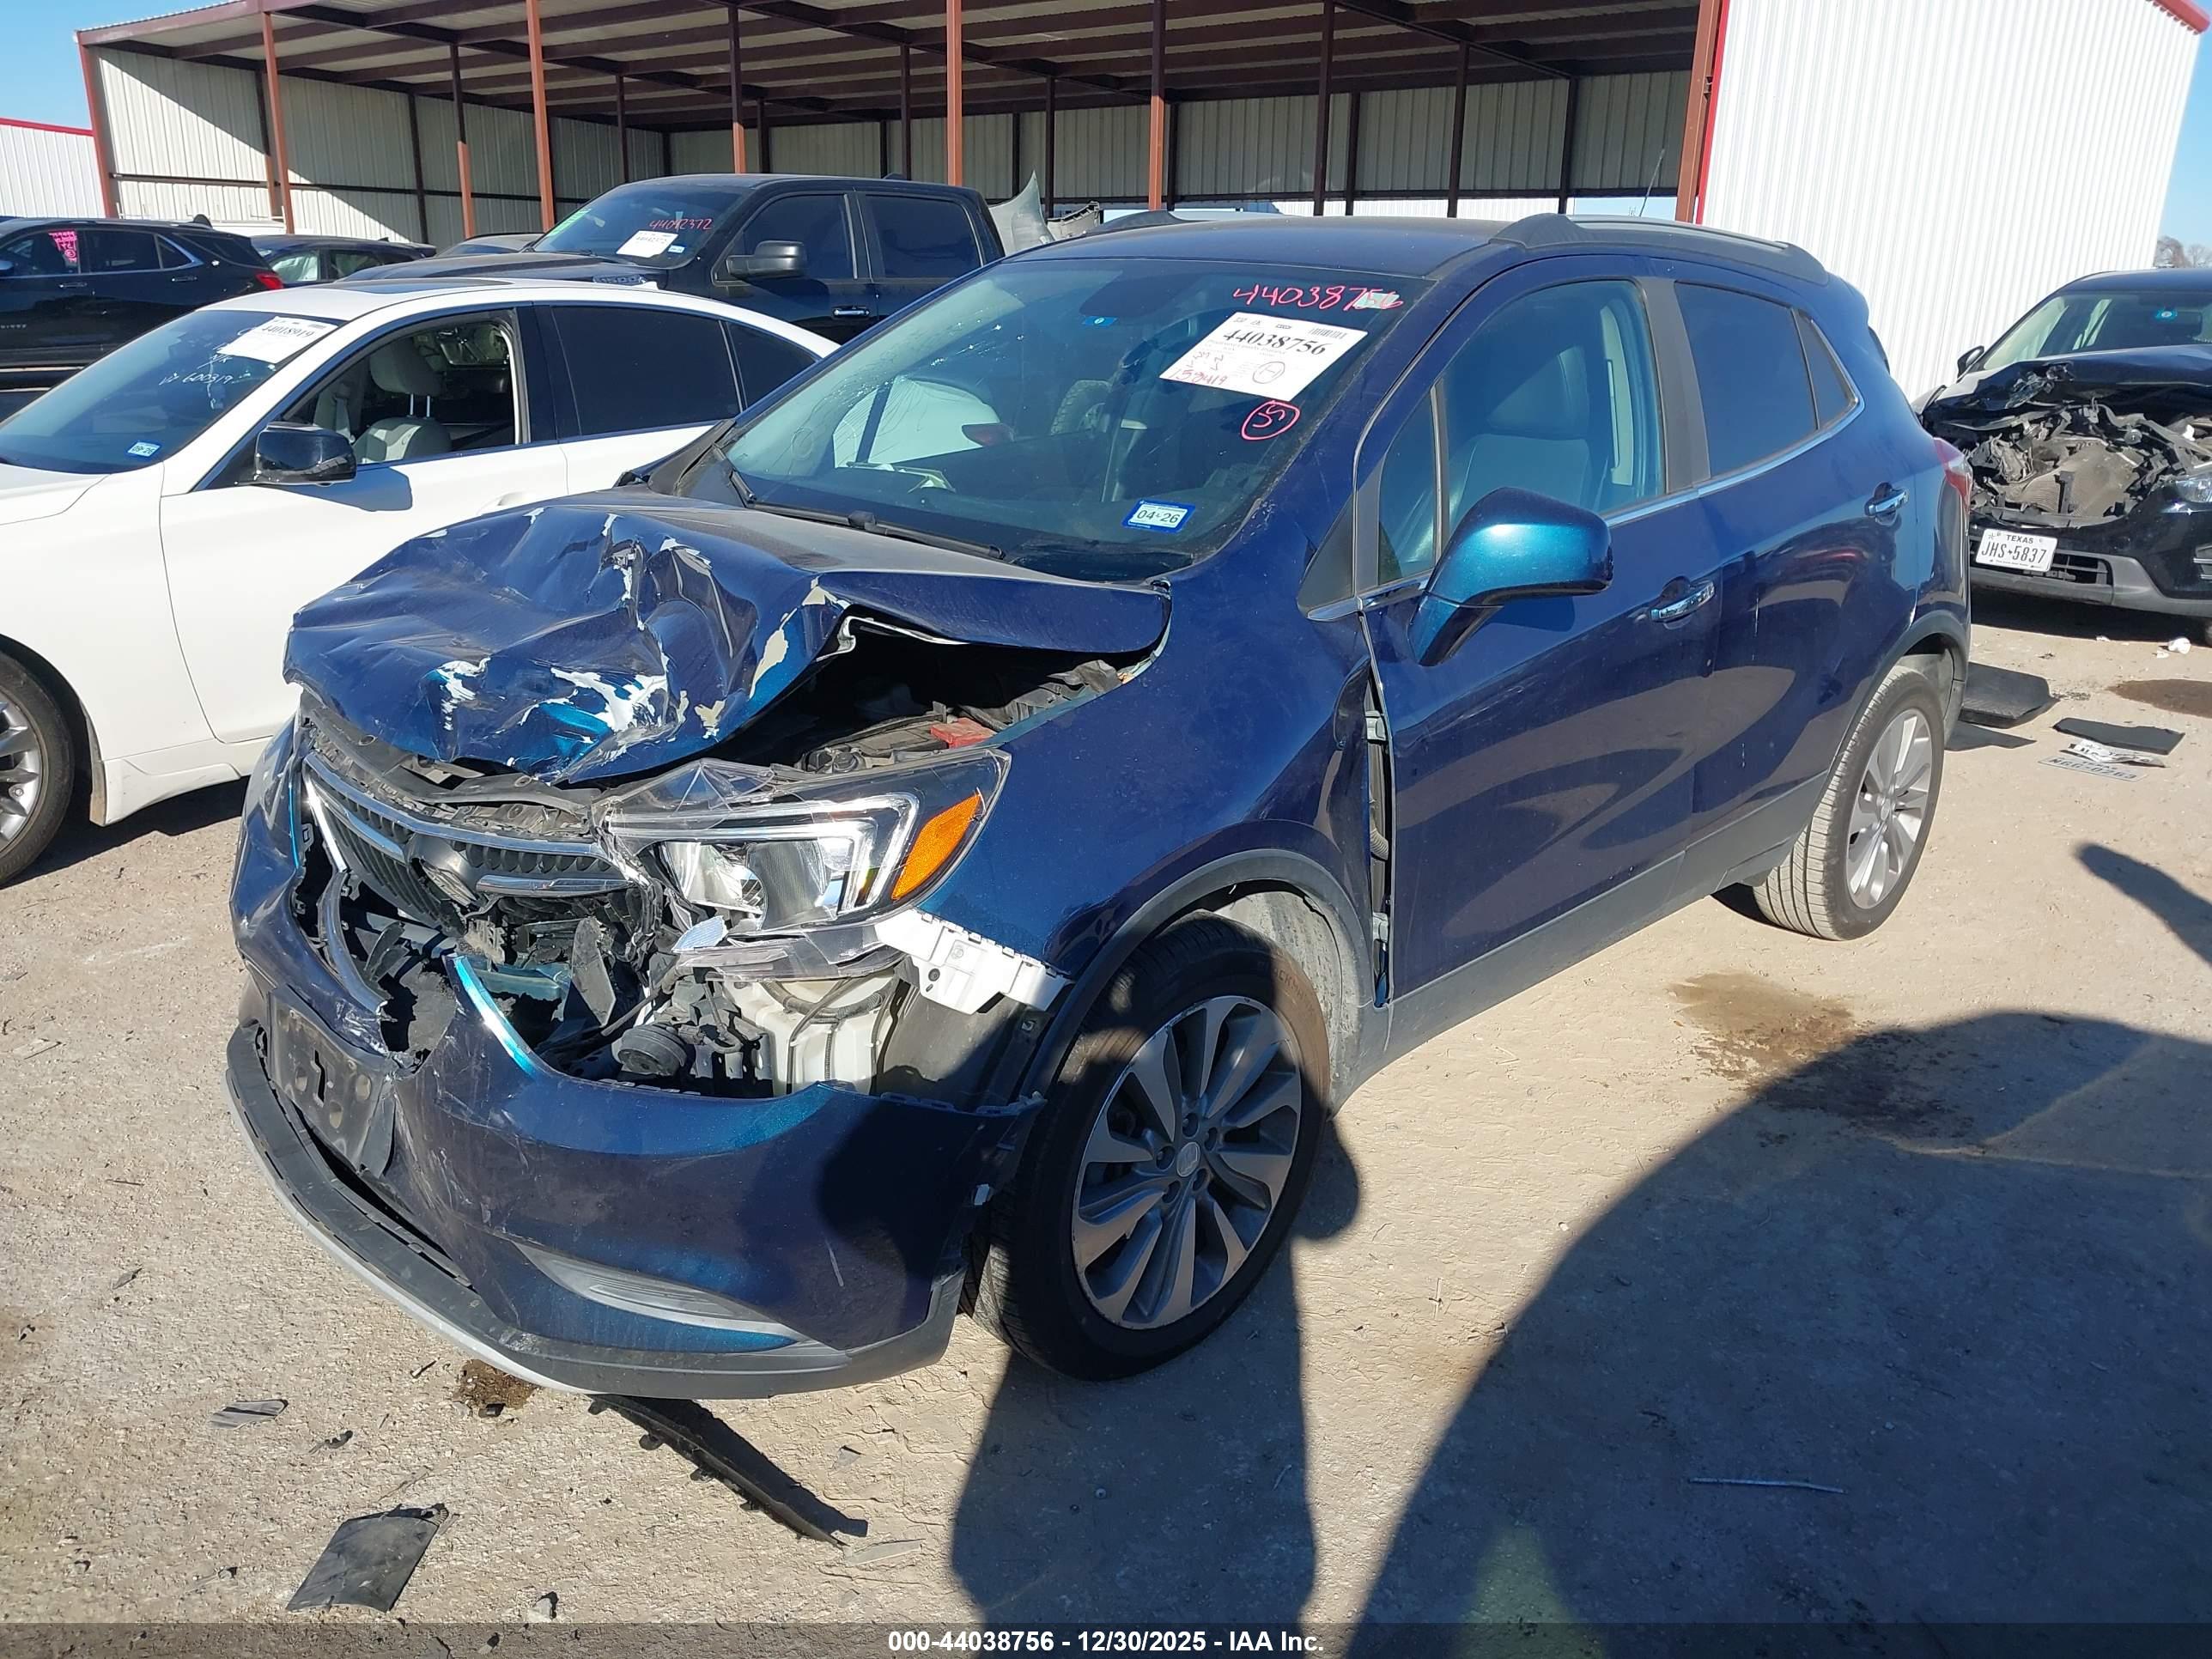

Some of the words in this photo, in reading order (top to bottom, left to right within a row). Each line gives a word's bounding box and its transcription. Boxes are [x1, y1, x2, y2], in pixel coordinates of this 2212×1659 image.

[1223, 329, 1327, 356] 44038756
[1136, 509, 1181, 524] 04-26
[2007, 534, 2034, 544] TEXAS
